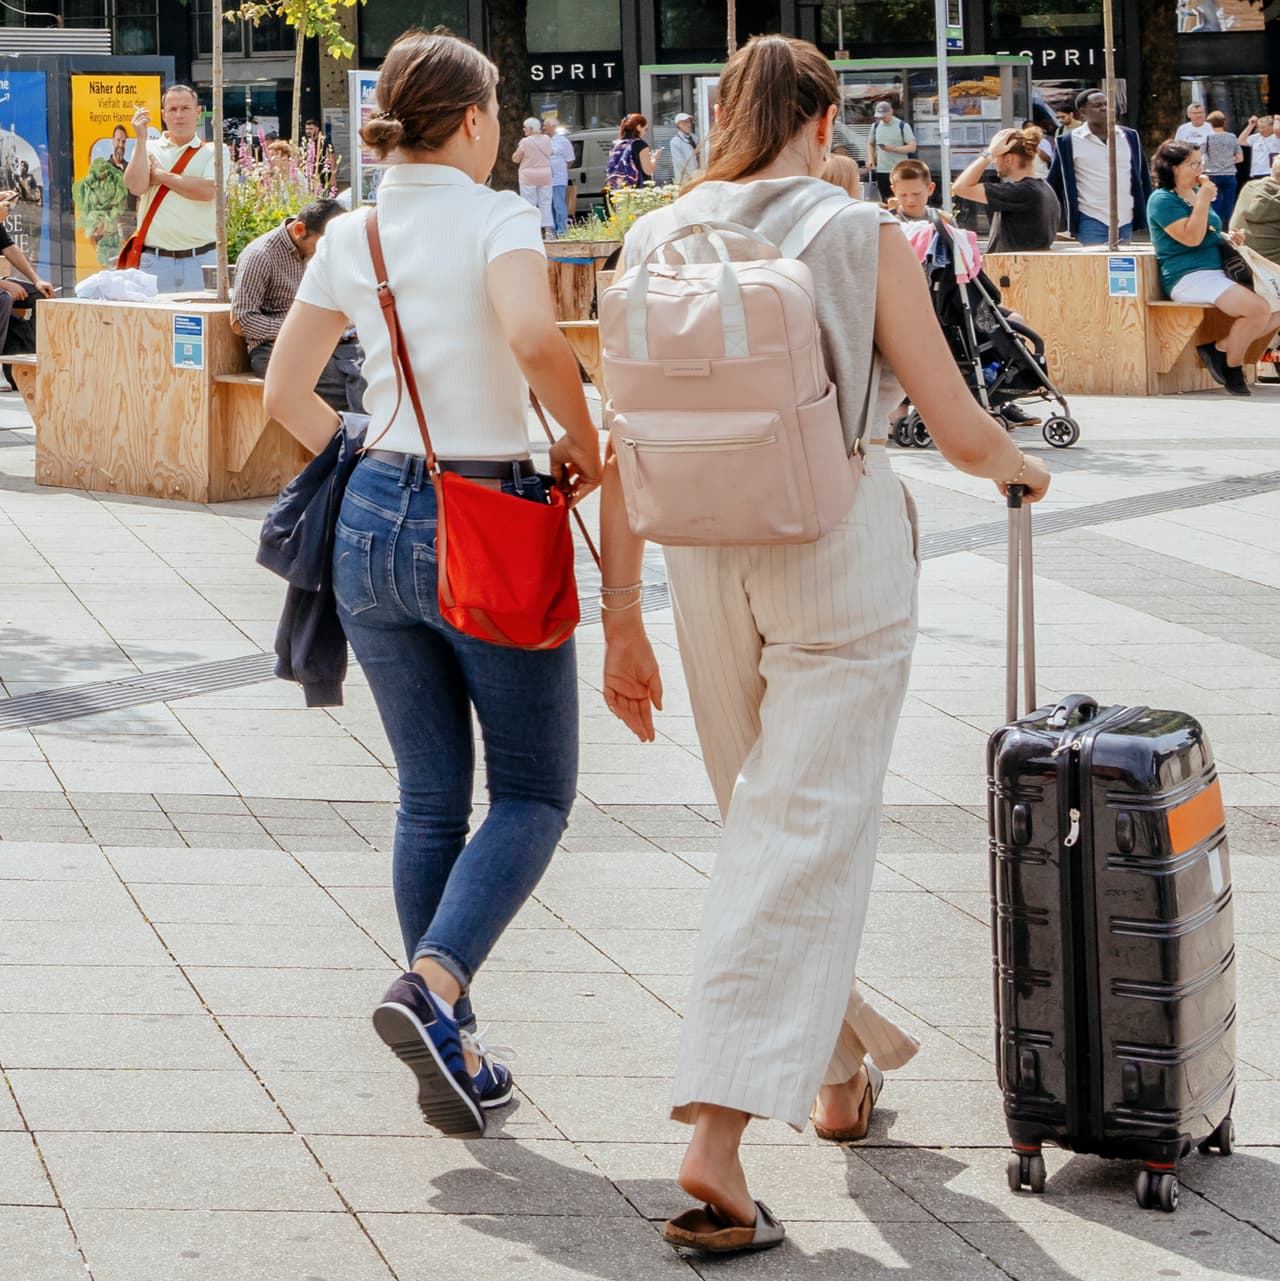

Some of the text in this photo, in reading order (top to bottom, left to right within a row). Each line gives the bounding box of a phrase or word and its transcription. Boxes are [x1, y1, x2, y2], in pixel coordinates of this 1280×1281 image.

[531, 62, 616, 80] SPRIT
[89, 81, 137, 94] Näher dran:
[98, 98, 120, 108] Vielfalt
[90, 112, 111, 125] Region
[3, 214, 23, 233] SE
